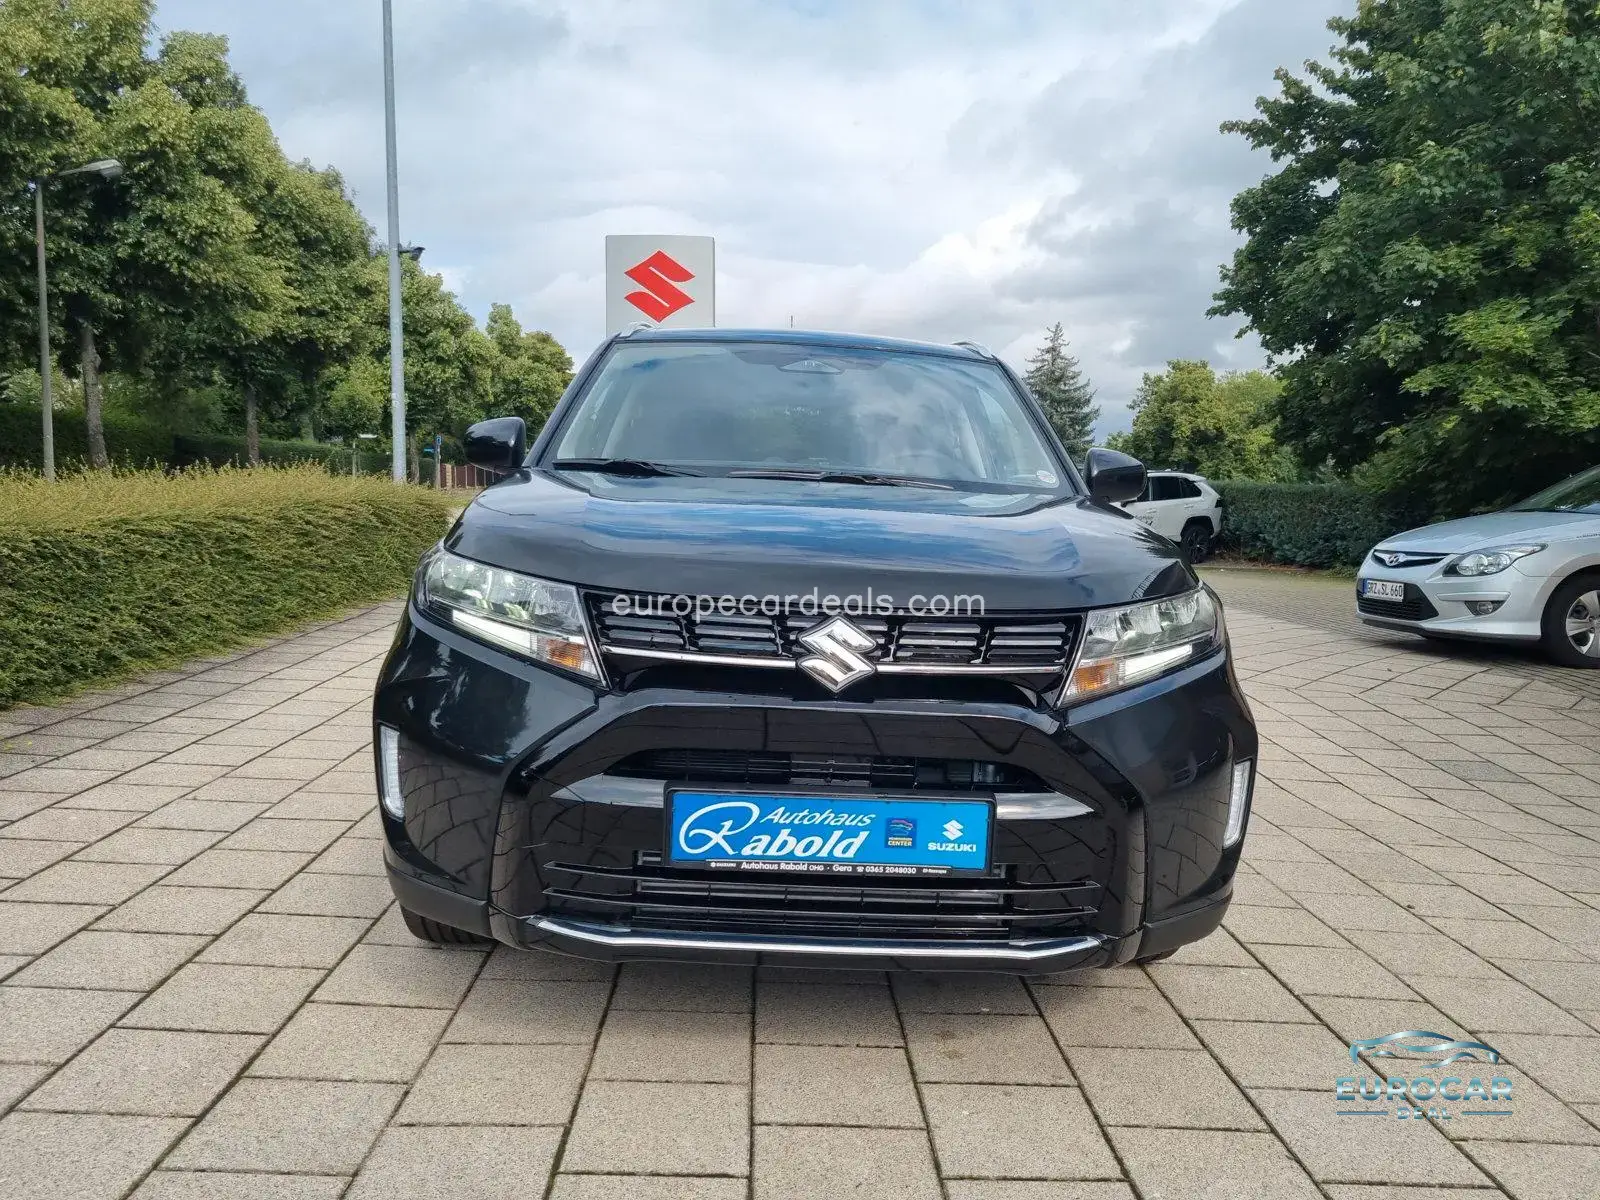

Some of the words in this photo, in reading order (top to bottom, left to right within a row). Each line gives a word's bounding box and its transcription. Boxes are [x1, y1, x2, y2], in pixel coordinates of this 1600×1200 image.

[1380, 583, 1389, 596] SL
[1390, 585, 1403, 597] 660
[759, 806, 877, 827] Autohaus
[678, 801, 871, 859] Rabold
[928, 842, 977, 852] SUZUKI
[741, 861, 778, 870] Autohaus
[780, 862, 807, 871] Rabold
[832, 864, 852, 872] Gera
[885, 866, 917, 874] 2048030
